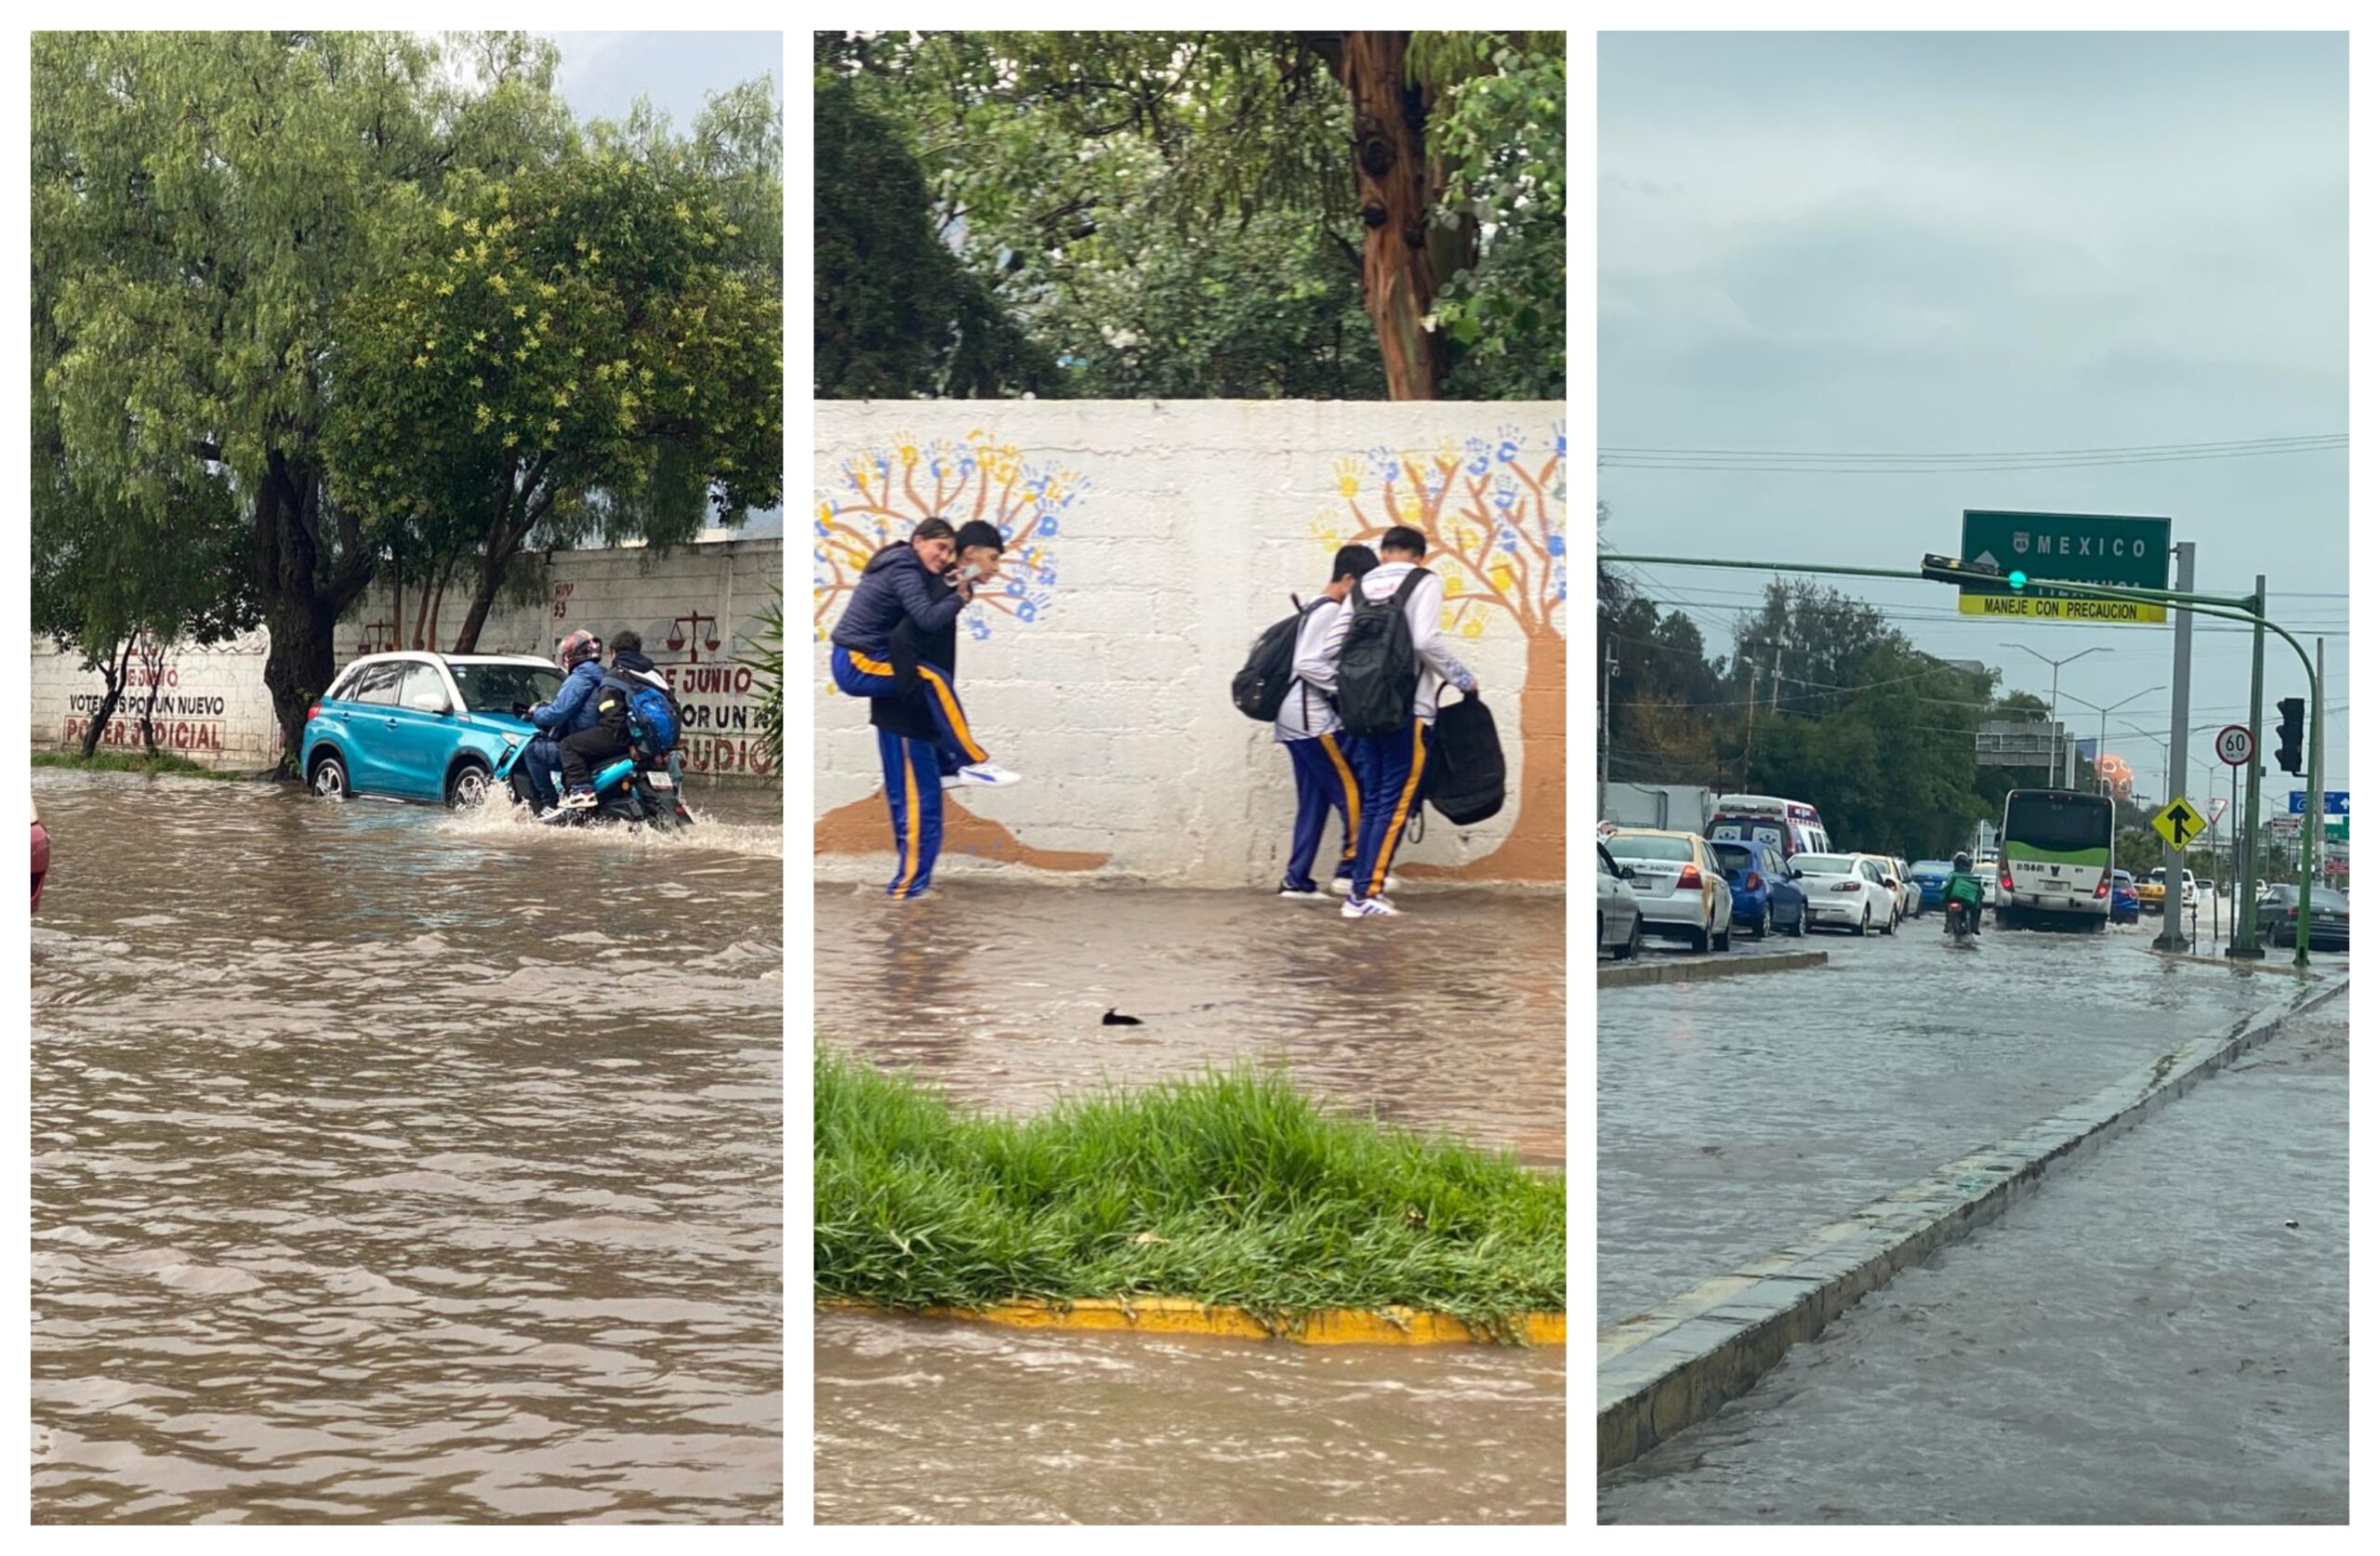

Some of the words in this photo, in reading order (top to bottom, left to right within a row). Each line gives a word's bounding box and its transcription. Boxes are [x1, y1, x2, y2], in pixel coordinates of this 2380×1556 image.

[2037, 534, 2146, 558] MEXICO
[1984, 598, 2029, 614] MANEJE
[2035, 600, 2059, 616] CON
[2066, 601, 2137, 620] PRECAUCION
[682, 666, 752, 693] JUNIO
[70, 693, 126, 714] VOTES
[128, 695, 152, 714] PO
[155, 696, 175, 714] UN
[178, 696, 225, 715] NUEVO
[681, 704, 710, 728] OR
[715, 705, 747, 729] UN
[67, 719, 126, 745] POER
[131, 720, 221, 750] JDICIAL
[2226, 733, 2245, 752] 60
